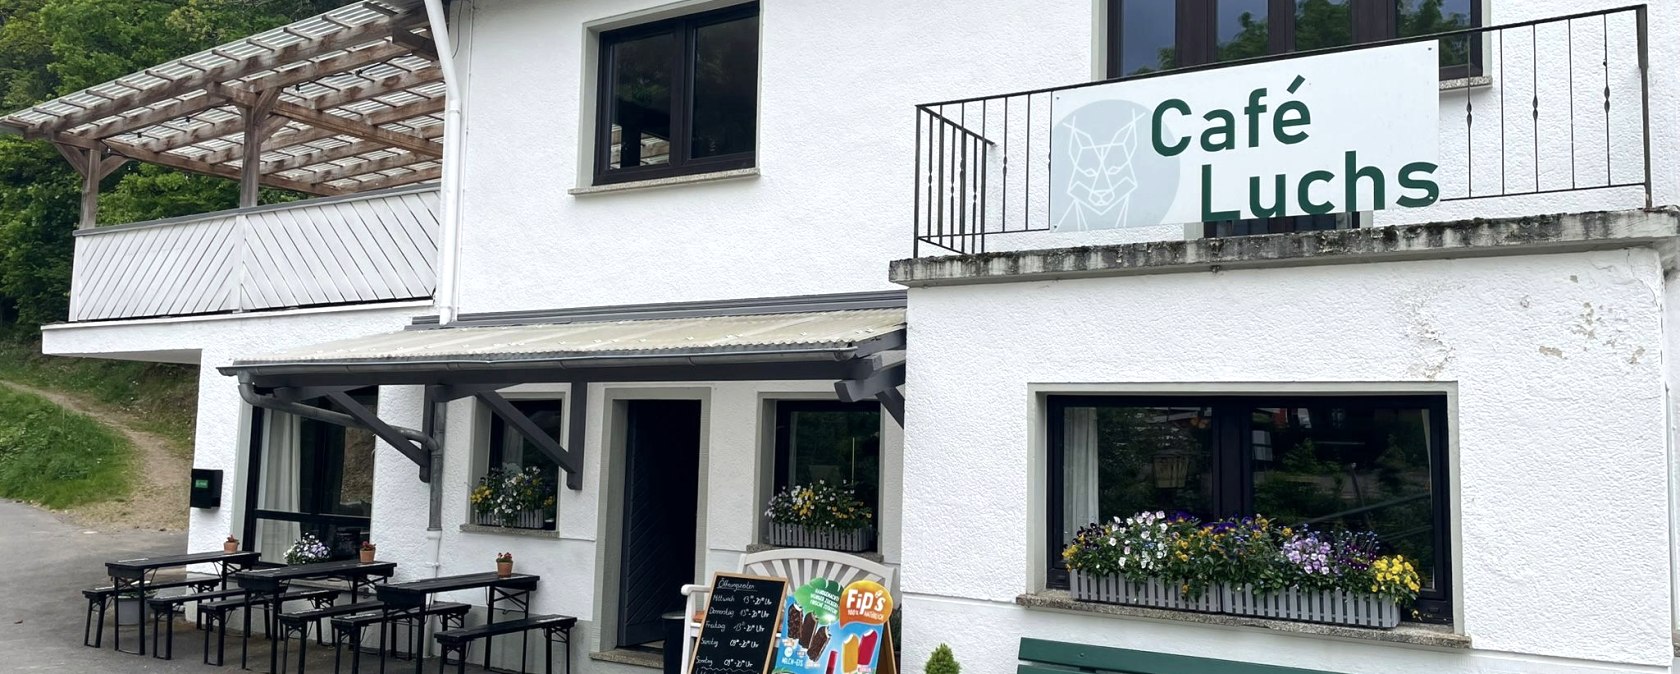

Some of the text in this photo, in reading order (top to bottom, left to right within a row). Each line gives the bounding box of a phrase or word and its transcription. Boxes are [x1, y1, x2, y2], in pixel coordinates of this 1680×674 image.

[1151, 74, 1311, 157] Café
[1201, 150, 1440, 222] Luchs
[846, 589, 886, 615] Fip's
